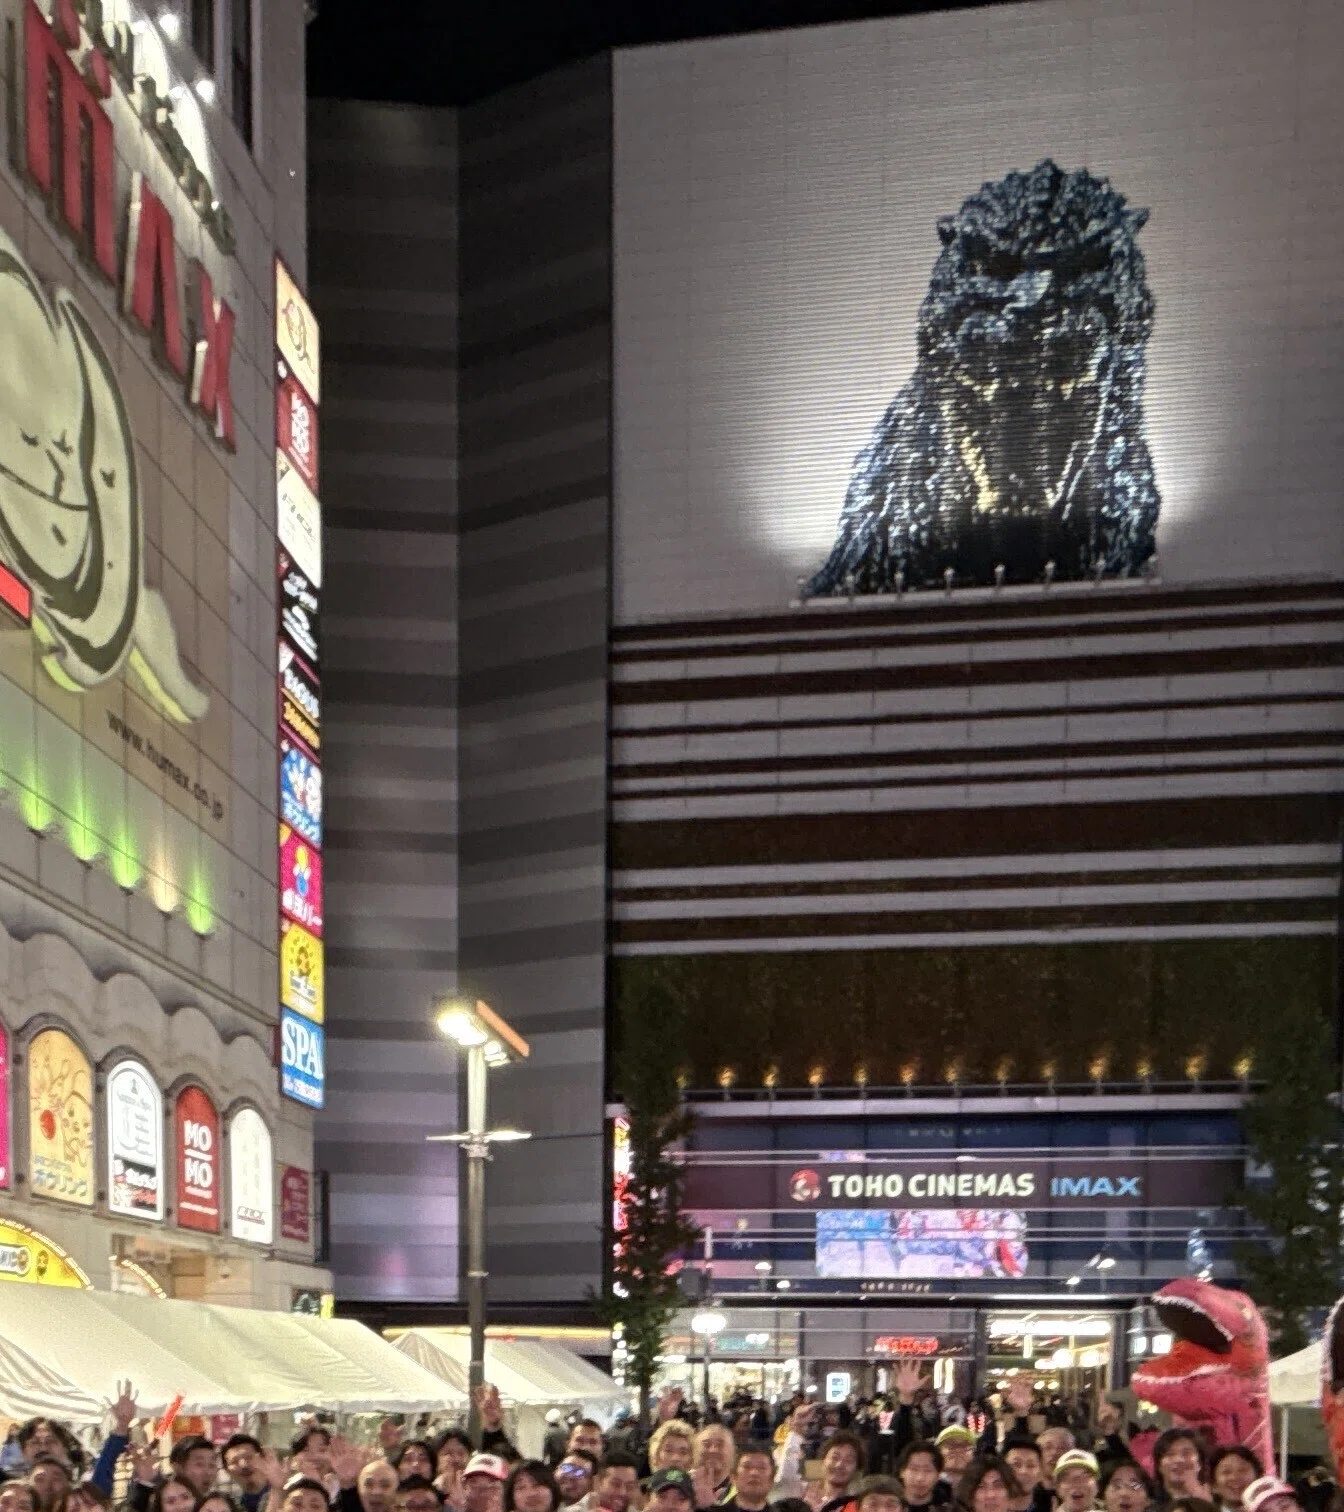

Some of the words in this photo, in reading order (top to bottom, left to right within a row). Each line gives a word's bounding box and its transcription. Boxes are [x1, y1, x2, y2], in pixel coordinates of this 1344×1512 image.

[281, 1015, 324, 1080] SPA
[183, 1119, 213, 1152] MO
[184, 1158, 213, 1188] MO
[827, 1174, 904, 1198] TOHO
[907, 1172, 1035, 1198] CINEMAS
[1050, 1176, 1143, 1197] IMAX
